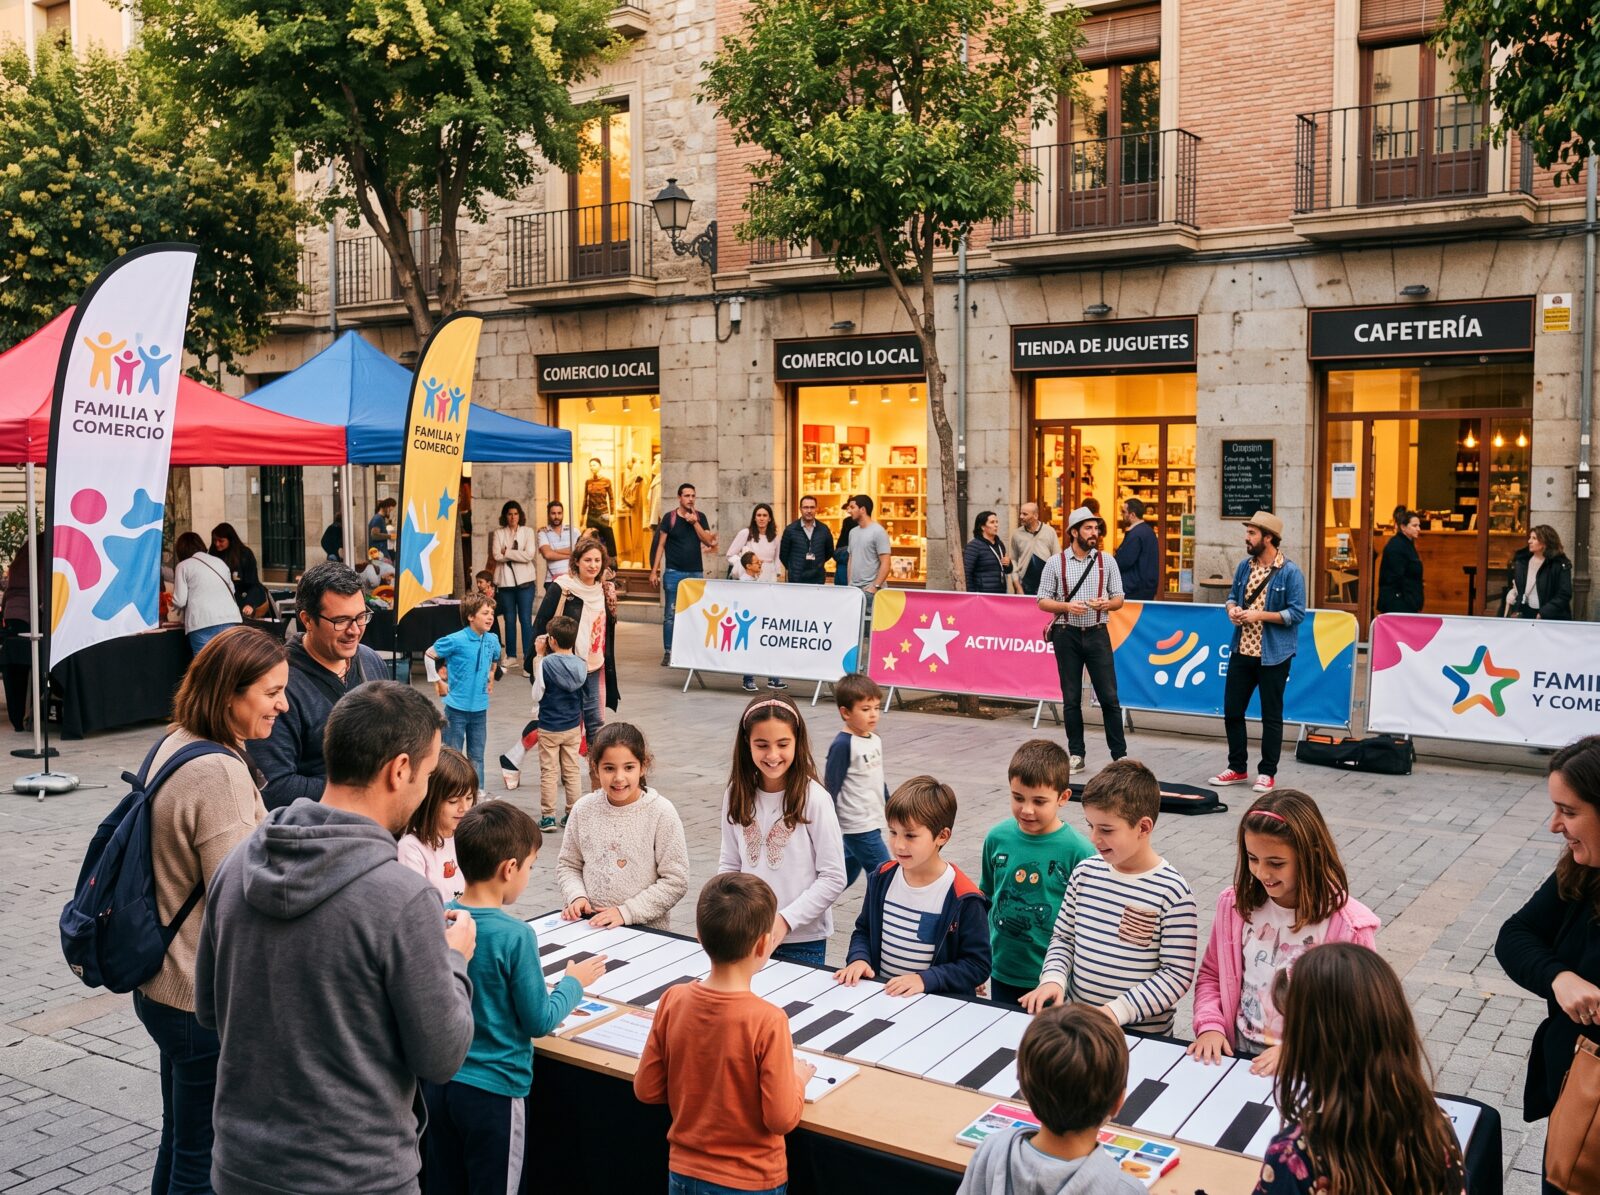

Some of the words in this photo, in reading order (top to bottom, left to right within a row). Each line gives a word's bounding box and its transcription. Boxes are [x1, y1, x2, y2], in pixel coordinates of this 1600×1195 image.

[1353, 314, 1483, 343] CAFETERÍA
[1017, 339, 1076, 356] TIENDA
[1079, 338, 1101, 354] DE
[1104, 333, 1189, 353] JUGUETES
[781, 350, 864, 369] COMERCIO
[866, 347, 920, 365] LOCAL
[543, 364, 610, 381] COMERCIO
[612, 361, 655, 378] LOCAL
[74, 399, 149, 421] FAMILIA
[153, 409, 165, 423] Y
[72, 419, 165, 440] COMERCIO
[414, 425, 453, 442] FAMILIA
[455, 432, 461, 443] Y
[413, 439, 460, 456] COMERCIO
[761, 617, 819, 634] FAMILIA
[823, 621, 833, 634] Y
[759, 634, 833, 651] COMERCIO
[1532, 693, 1545, 707] Y
